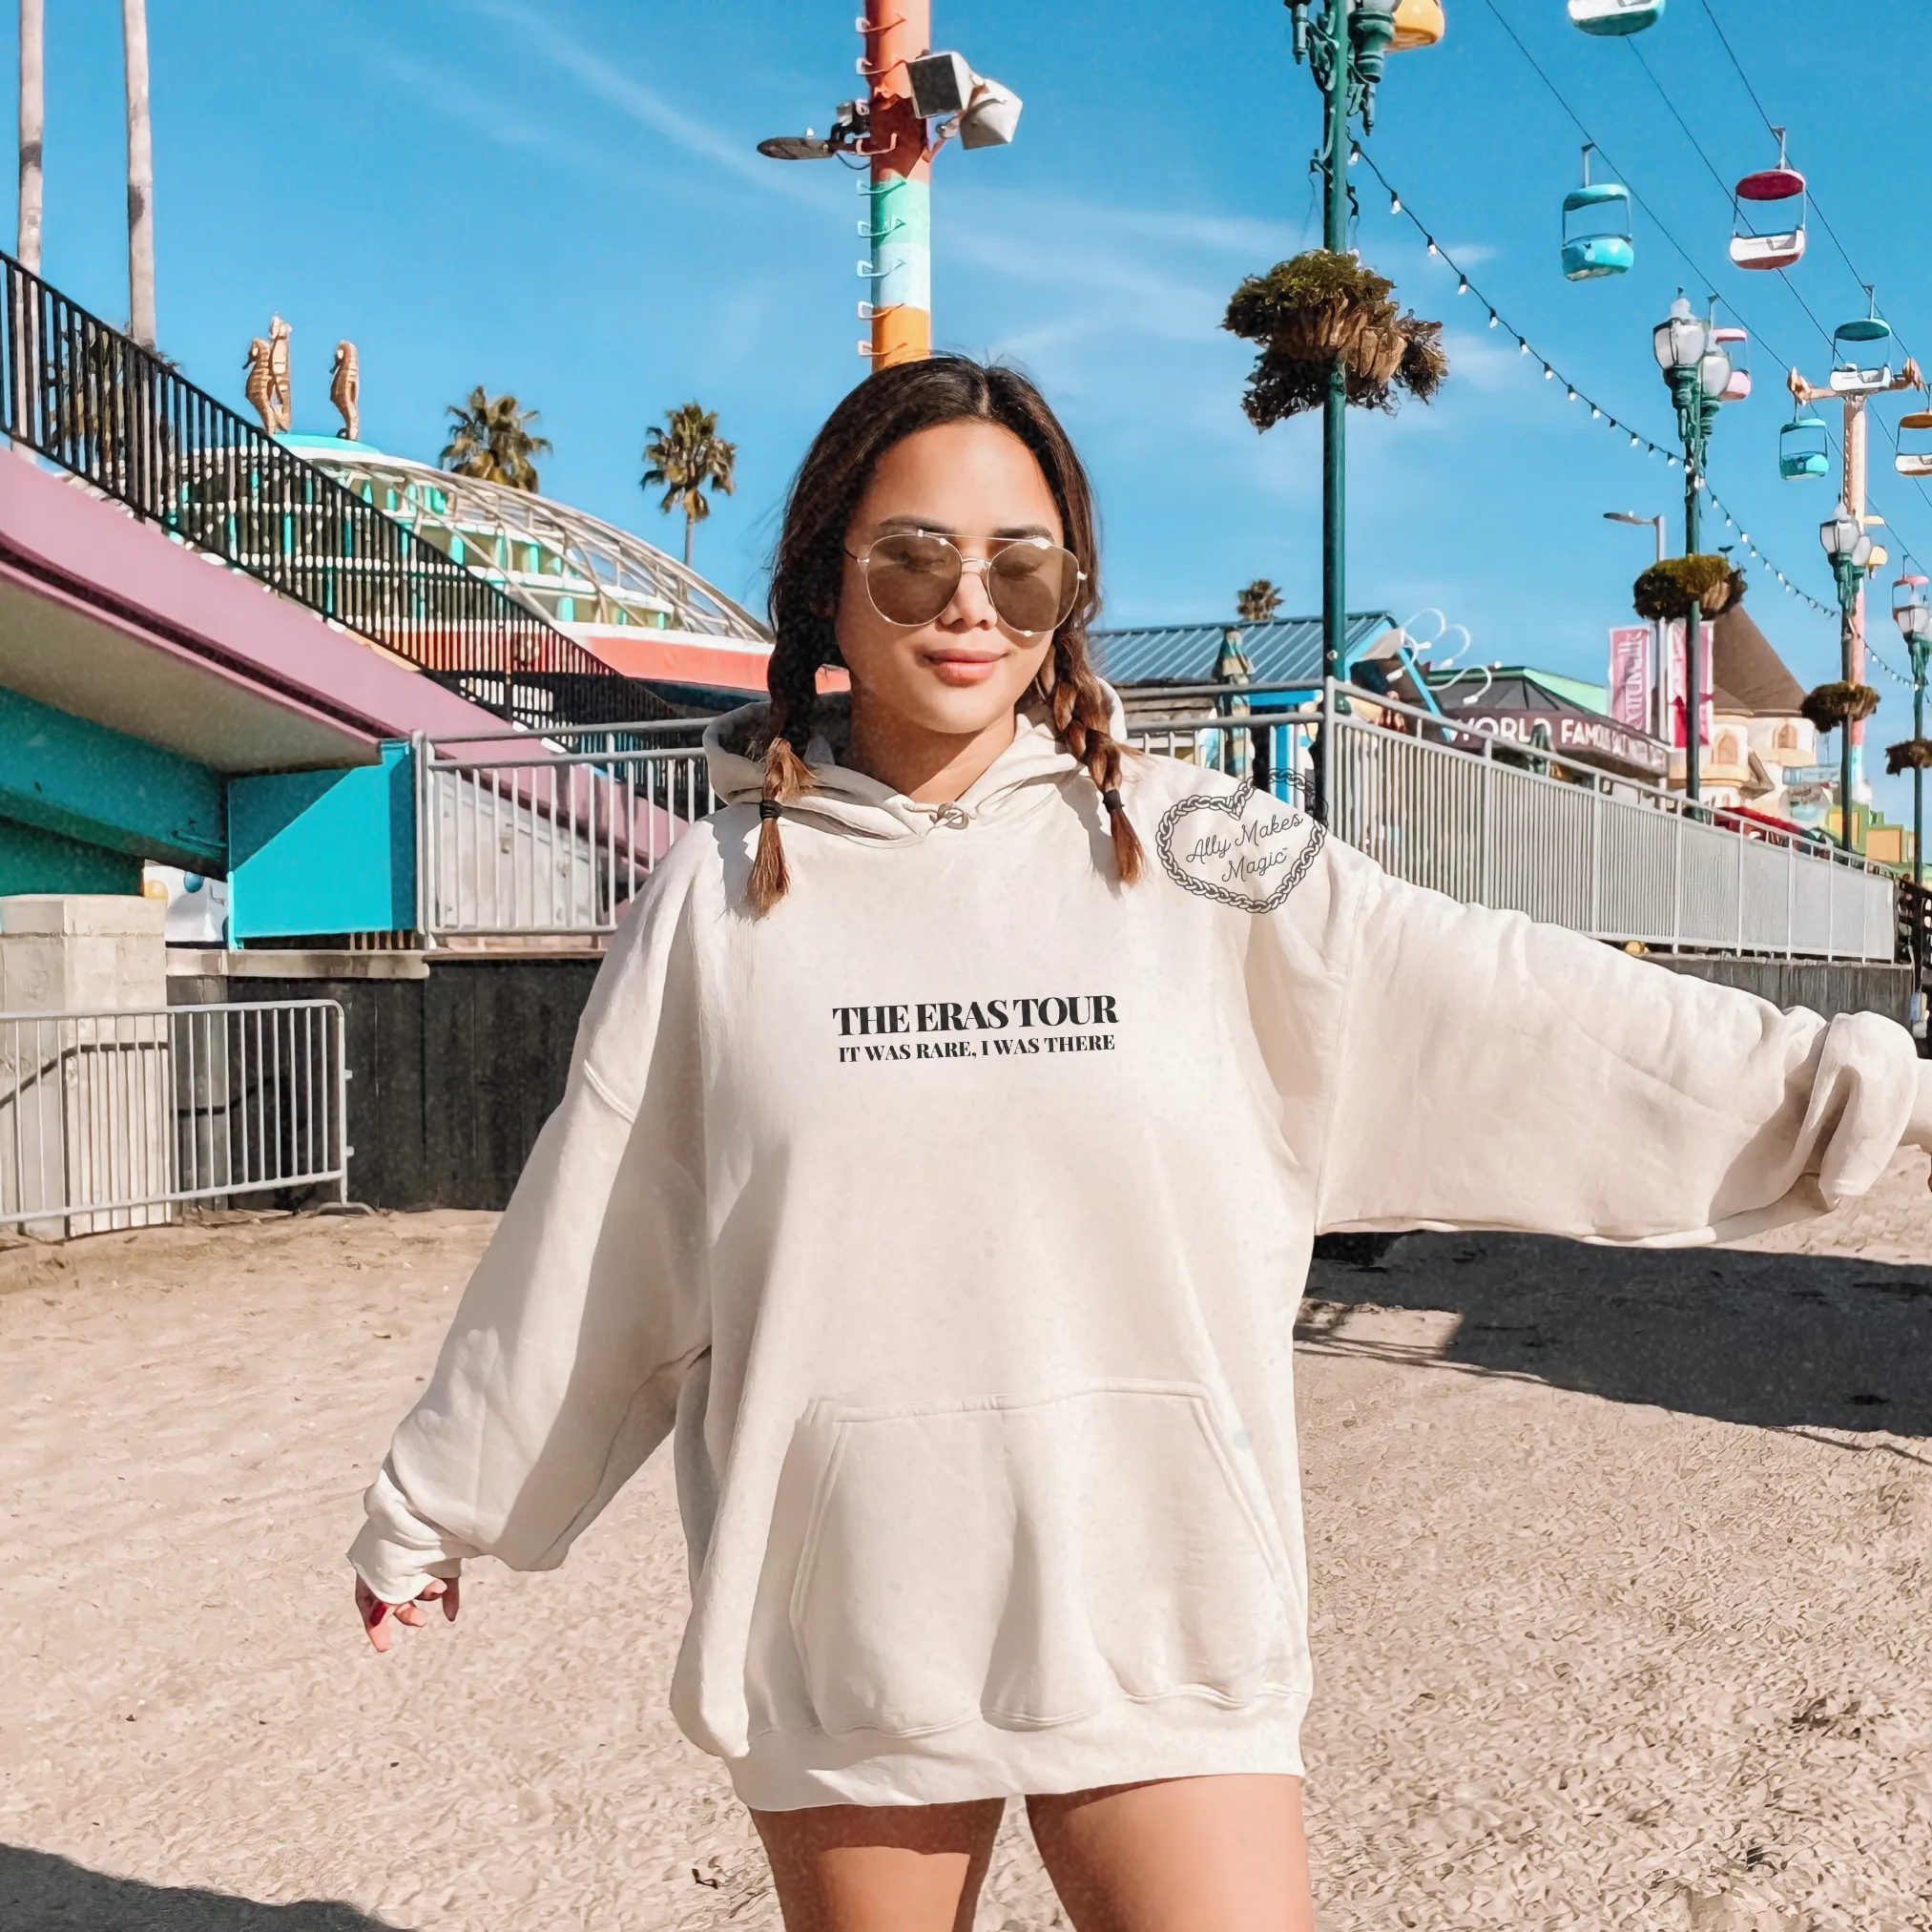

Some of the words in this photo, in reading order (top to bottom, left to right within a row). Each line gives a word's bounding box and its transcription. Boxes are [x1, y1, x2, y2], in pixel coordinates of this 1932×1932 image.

[833, 1005, 910, 1036] THE
[915, 1000, 1009, 1032] ERAS
[1013, 995, 1119, 1028] TOUR
[839, 1047, 860, 1063] IT
[864, 1044, 911, 1061] WAS
[916, 1041, 977, 1059] RARE,
[981, 1040, 989, 1056] I
[993, 1038, 1040, 1055] WAS
[1045, 1034, 1115, 1053] THERE
